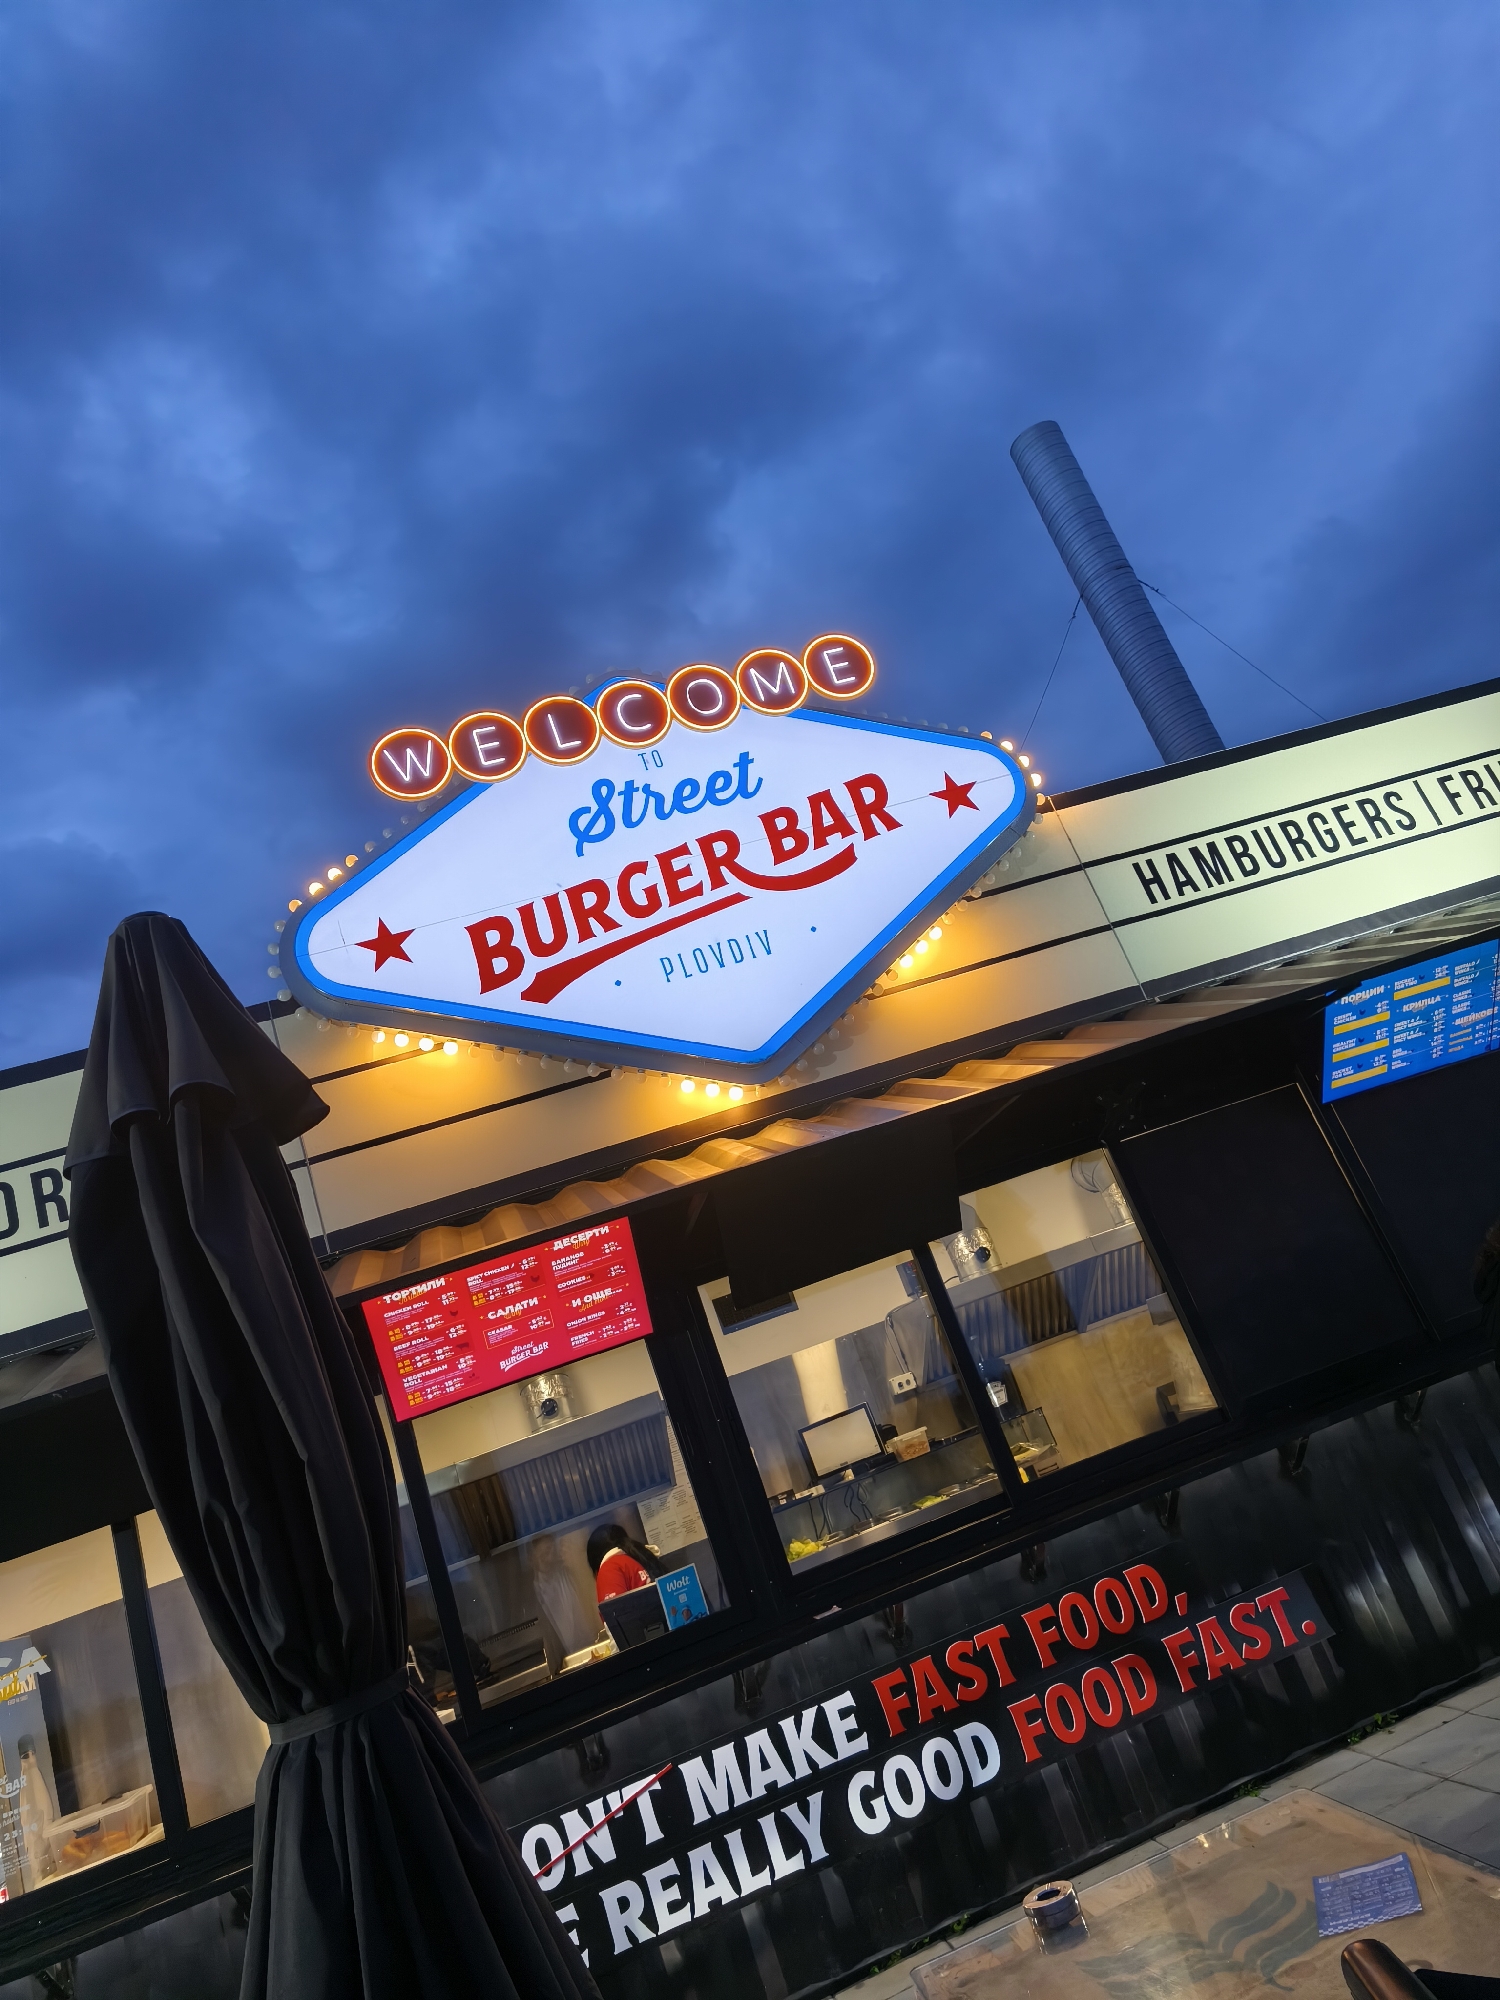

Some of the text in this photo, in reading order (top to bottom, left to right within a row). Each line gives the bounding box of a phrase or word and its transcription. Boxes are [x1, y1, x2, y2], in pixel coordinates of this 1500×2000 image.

[383, 648, 857, 784] WELCOME
[638, 749, 663, 772] TO
[568, 751, 763, 857] Street
[1132, 760, 1500, 904] HAMBURGERS FRI
[465, 773, 903, 995] BURGER BAR
[660, 930, 773, 983] PLOVDIV
[553, 1226, 609, 1250] ДЕСЕРТИ
[383, 1277, 446, 1304] ТОРТИЛИ
[488, 1297, 538, 1319] САЛАТИ
[499, 1342, 549, 1369] BURGER BAR
[667, 1576, 690, 1592] Wolt
[678, 1690, 869, 1826] MAKE
[871, 1624, 1017, 1738] FAST
[1021, 1563, 1188, 1669] FOOD,
[6, 1775, 27, 1793] BAR
[599, 1791, 829, 1956] REALLY
[847, 1721, 1000, 1835] GOOD
[1006, 1653, 1158, 1764] FOOD
[1161, 1586, 1317, 1694] FAST.
